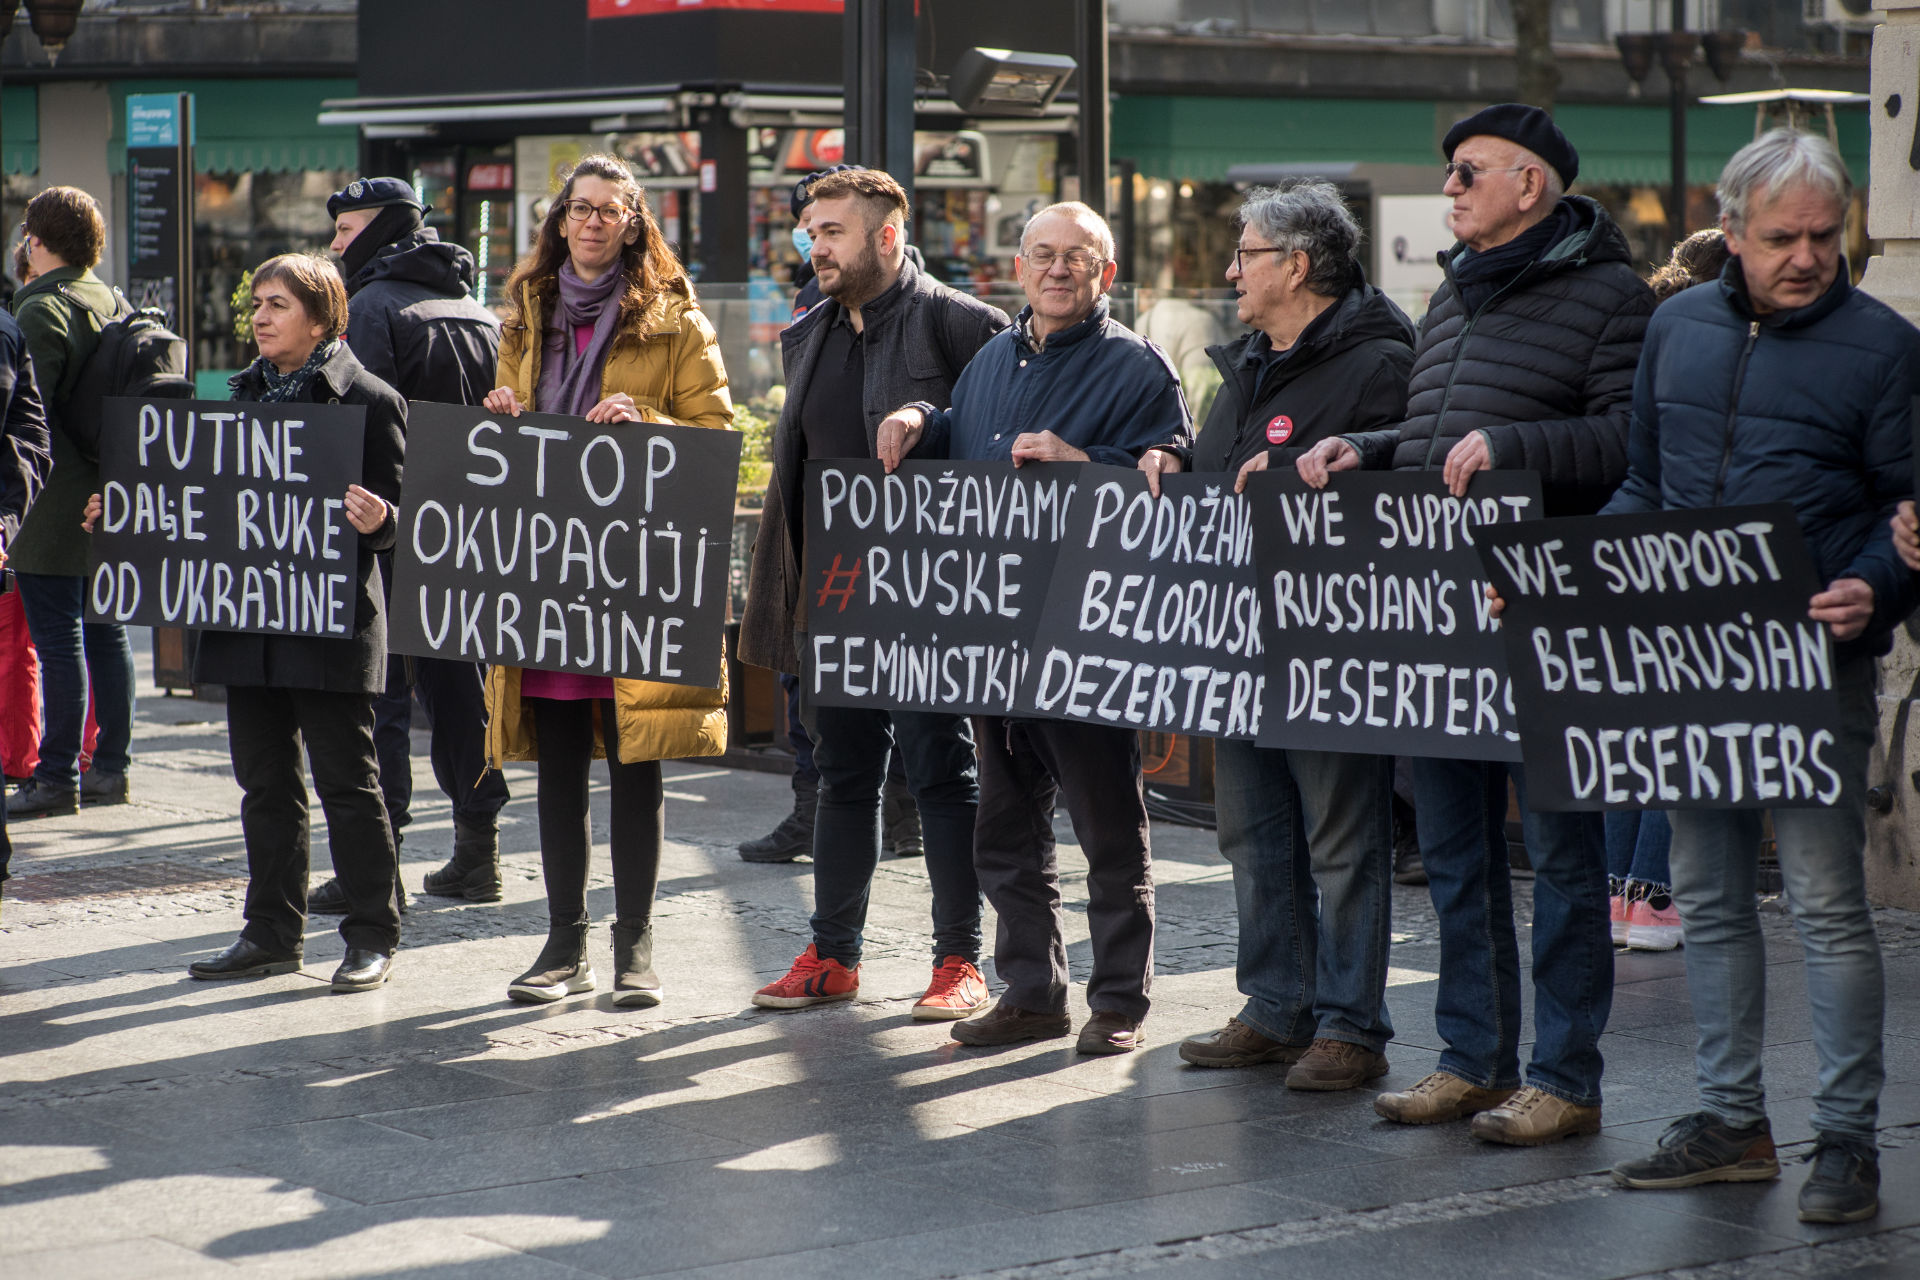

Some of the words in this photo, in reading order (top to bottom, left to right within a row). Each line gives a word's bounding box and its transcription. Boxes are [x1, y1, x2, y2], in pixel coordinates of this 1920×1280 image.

[138, 404, 309, 482] PUTINE
[466, 420, 676, 513] STOP
[237, 489, 343, 560] RUKE
[413, 500, 707, 608] OKUPACIJI
[1087, 481, 1253, 568] PODRŽAV
[1280, 492, 1346, 546] WE
[1493, 540, 1578, 596] WE
[1594, 522, 1781, 594] SUPPORT
[92, 561, 141, 622] OD
[160, 557, 347, 634] UKRAJINE
[816, 546, 1023, 619] #RUSKE
[1079, 570, 1265, 660] BELORUSK
[1274, 563, 1457, 635] RUSSIAN'S
[419, 585, 685, 677] UKRAJINE
[814, 631, 1029, 712] FEMINISTKI
[1532, 611, 1833, 694] BELARUSIAN
[1565, 723, 1842, 806] DESERTERS
